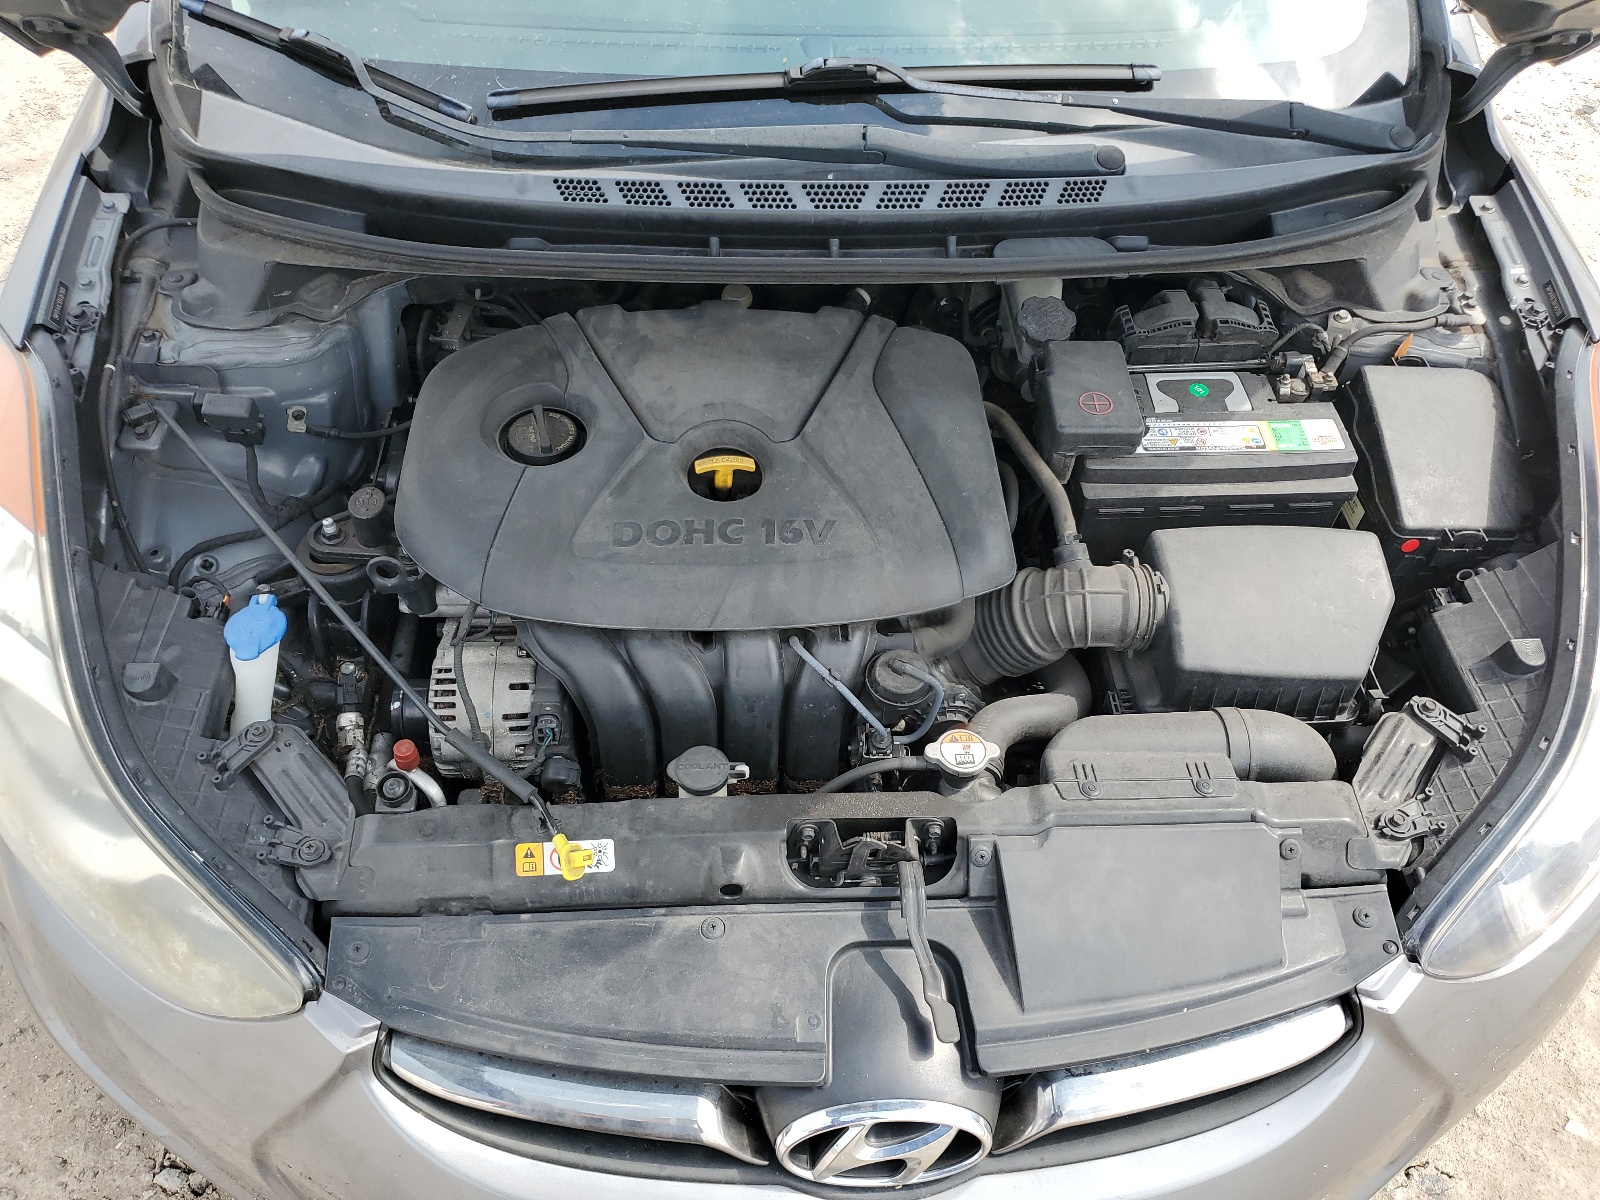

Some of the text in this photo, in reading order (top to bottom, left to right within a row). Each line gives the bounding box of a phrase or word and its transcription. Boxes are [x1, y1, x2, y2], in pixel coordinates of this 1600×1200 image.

[613, 518, 837, 547] DOHC 16V
[677, 762, 729, 771] COOLANT
